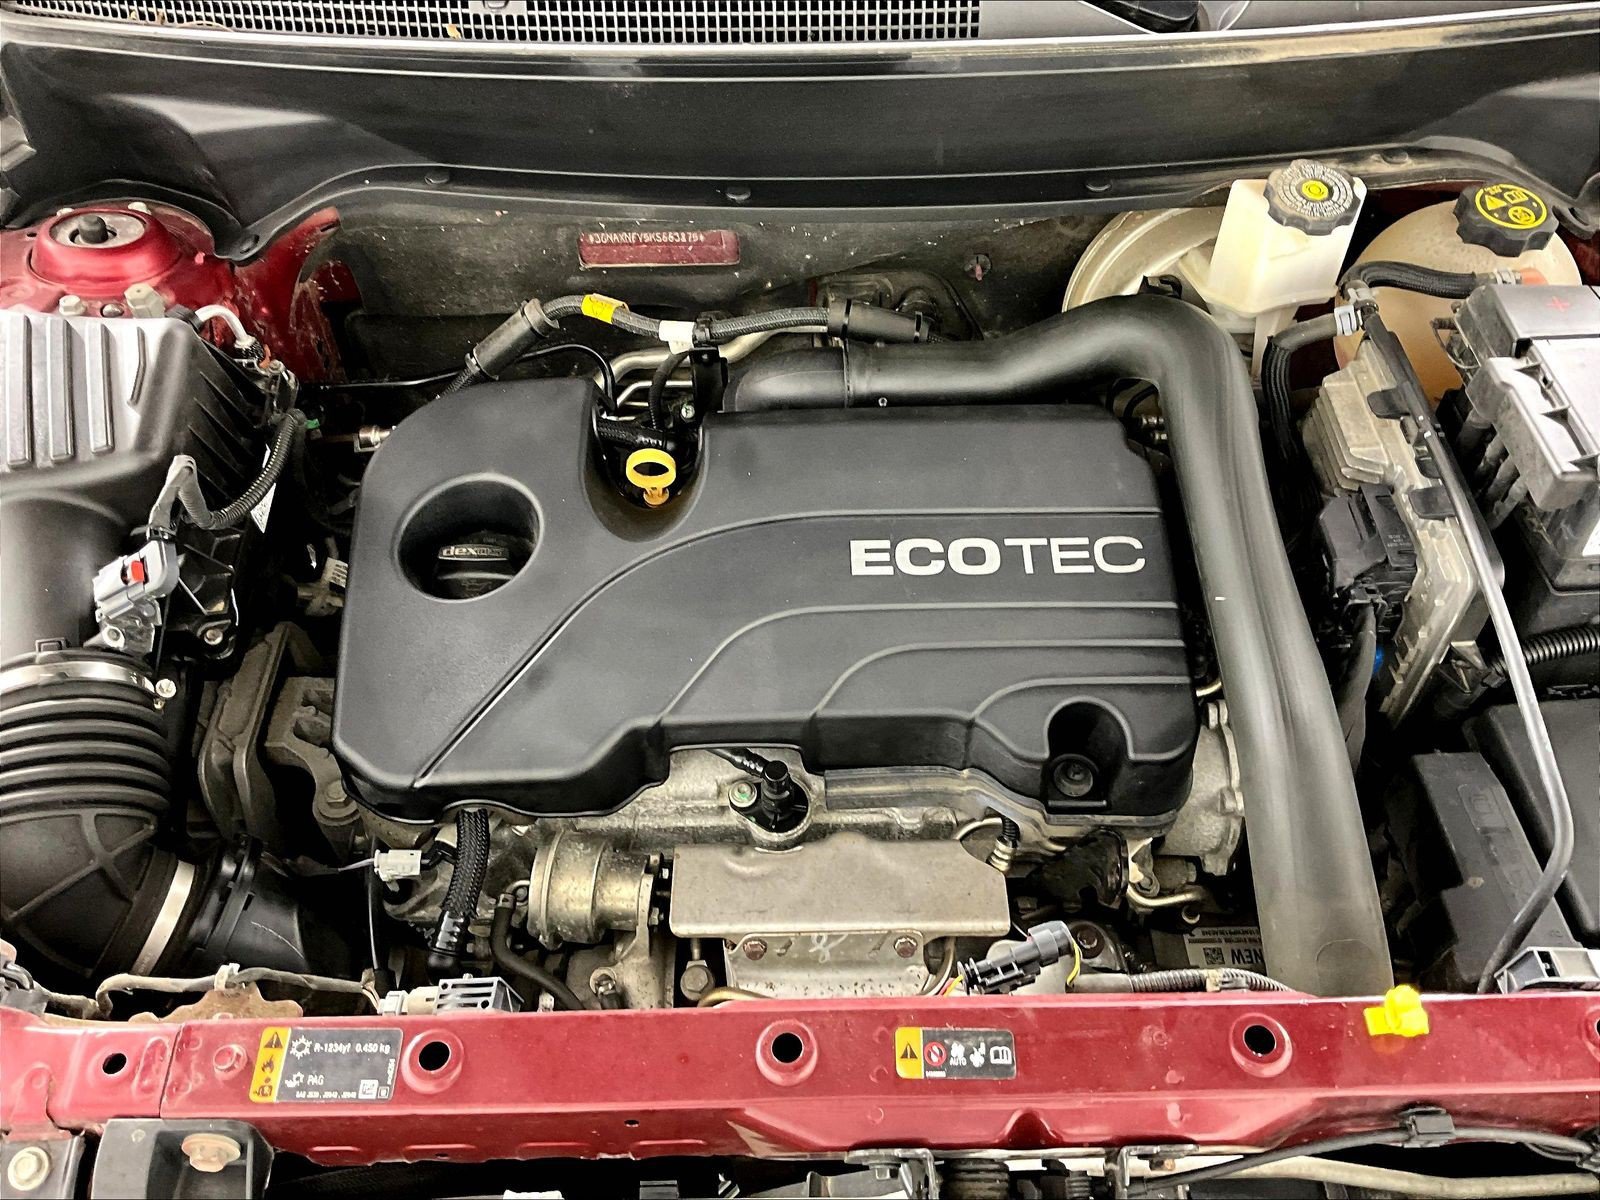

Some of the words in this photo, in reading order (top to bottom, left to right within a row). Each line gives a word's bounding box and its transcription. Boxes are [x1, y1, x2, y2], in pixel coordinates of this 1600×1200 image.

[850, 535, 1146, 576] ECOTEC
[1231, 948, 1264, 965] NEW
[313, 1042, 351, 1055] R-1234yf
[355, 1042, 378, 1053] 0.450
[949, 1057, 967, 1066] AUTO
[307, 1074, 325, 1086] PAG
